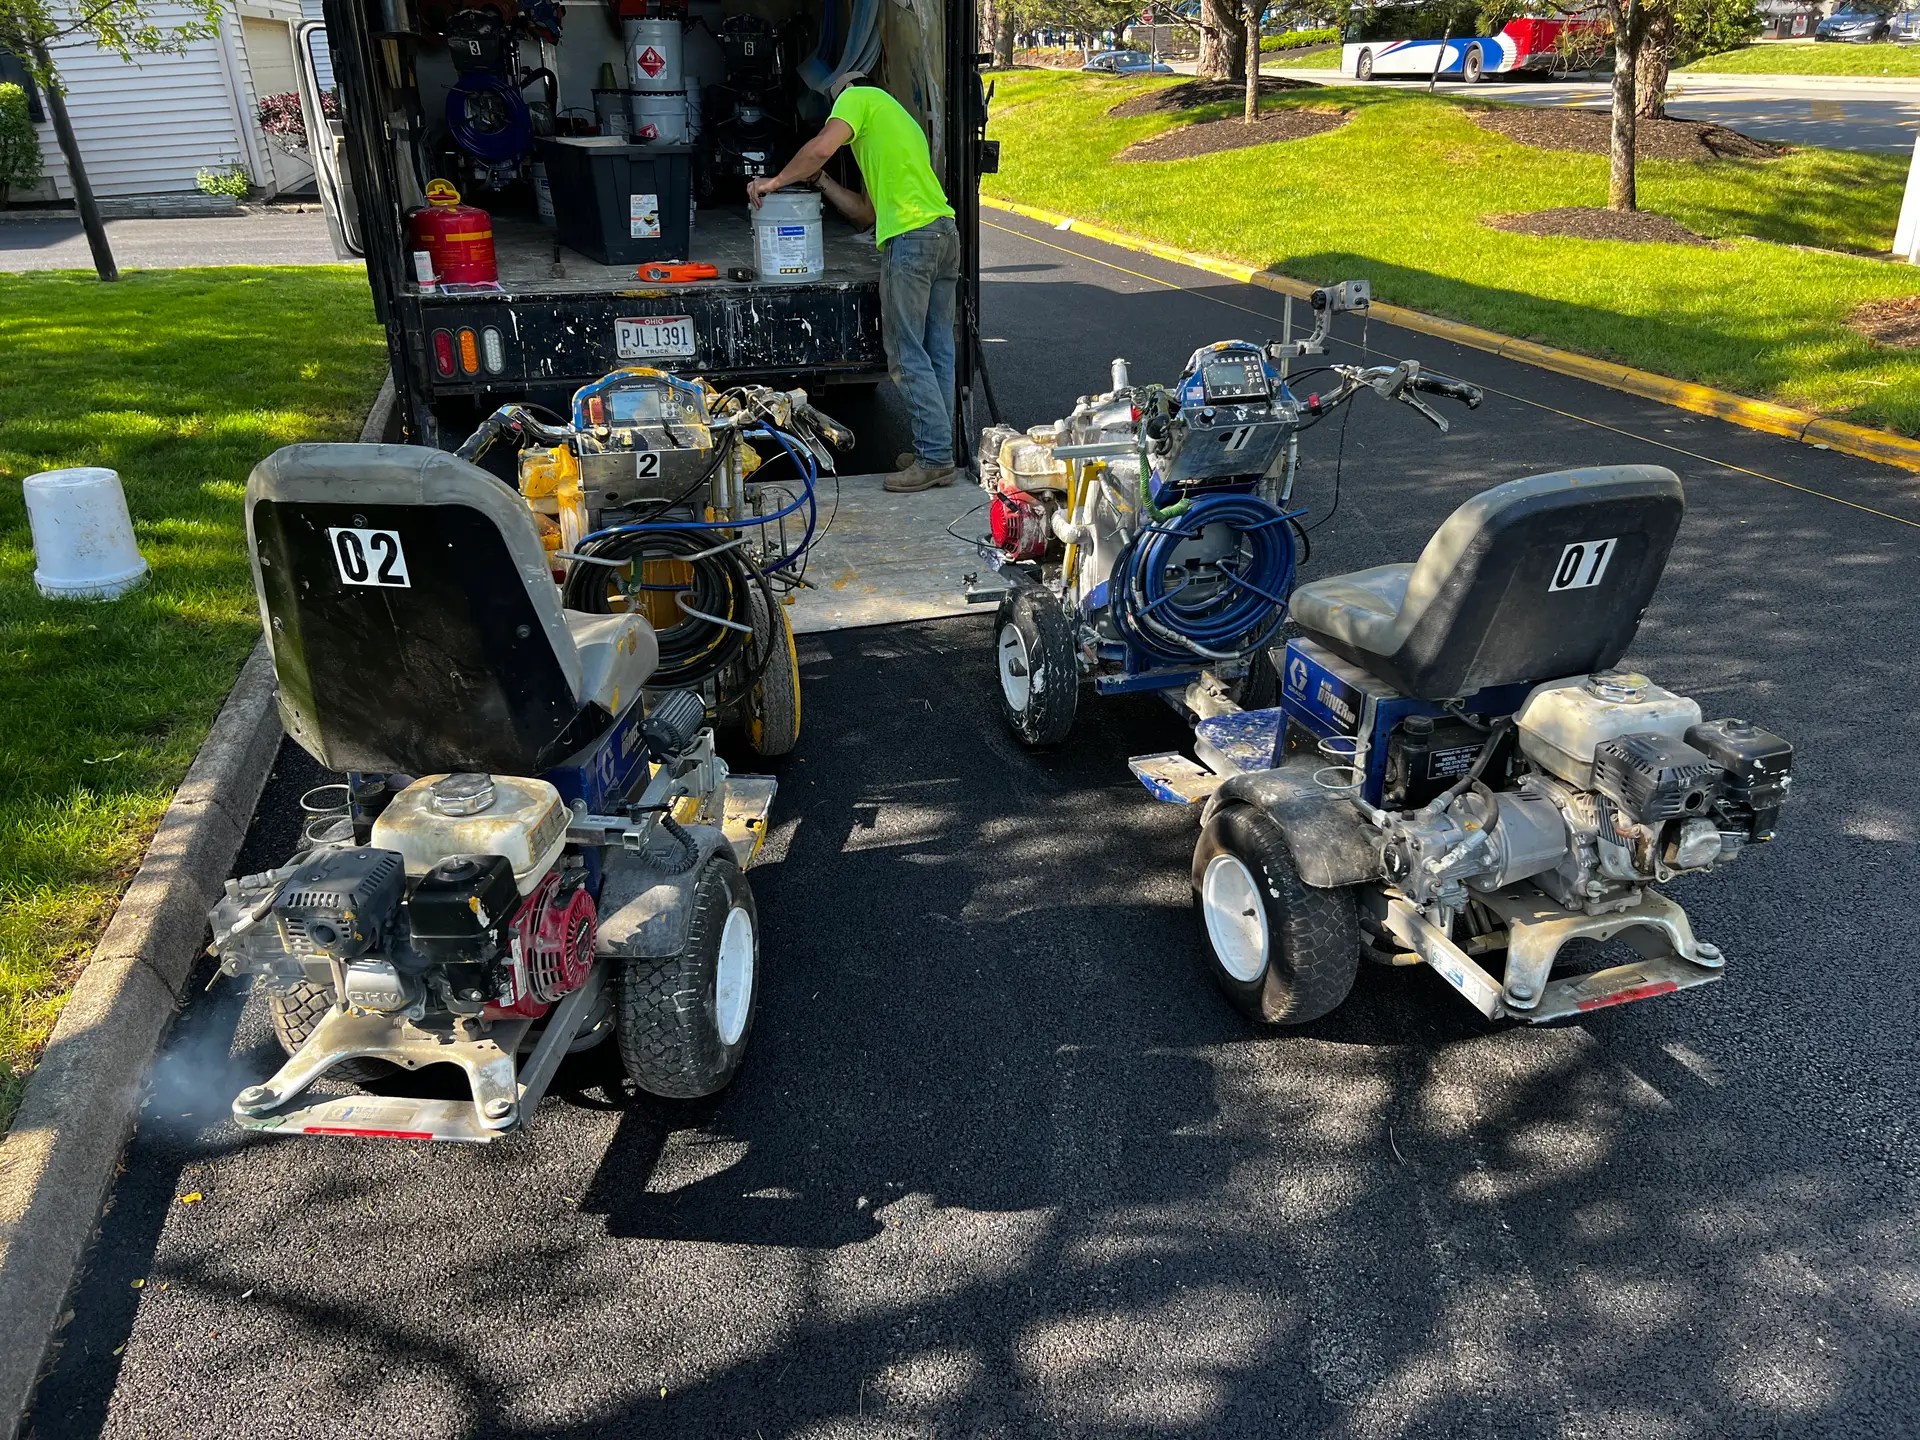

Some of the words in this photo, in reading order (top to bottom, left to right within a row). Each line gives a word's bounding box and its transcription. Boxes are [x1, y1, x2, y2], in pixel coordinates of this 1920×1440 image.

[470, 41, 478, 54] 3
[746, 43, 752, 54] 6
[621, 327, 650, 348] PJL
[654, 326, 689, 347] 1391
[1233, 426, 1251, 450] 1
[639, 453, 658, 478] 2
[336, 530, 405, 586] 02
[1555, 540, 1610, 589] 01
[1287, 684, 1307, 701] GRACO
[348, 991, 397, 1003] OHV
